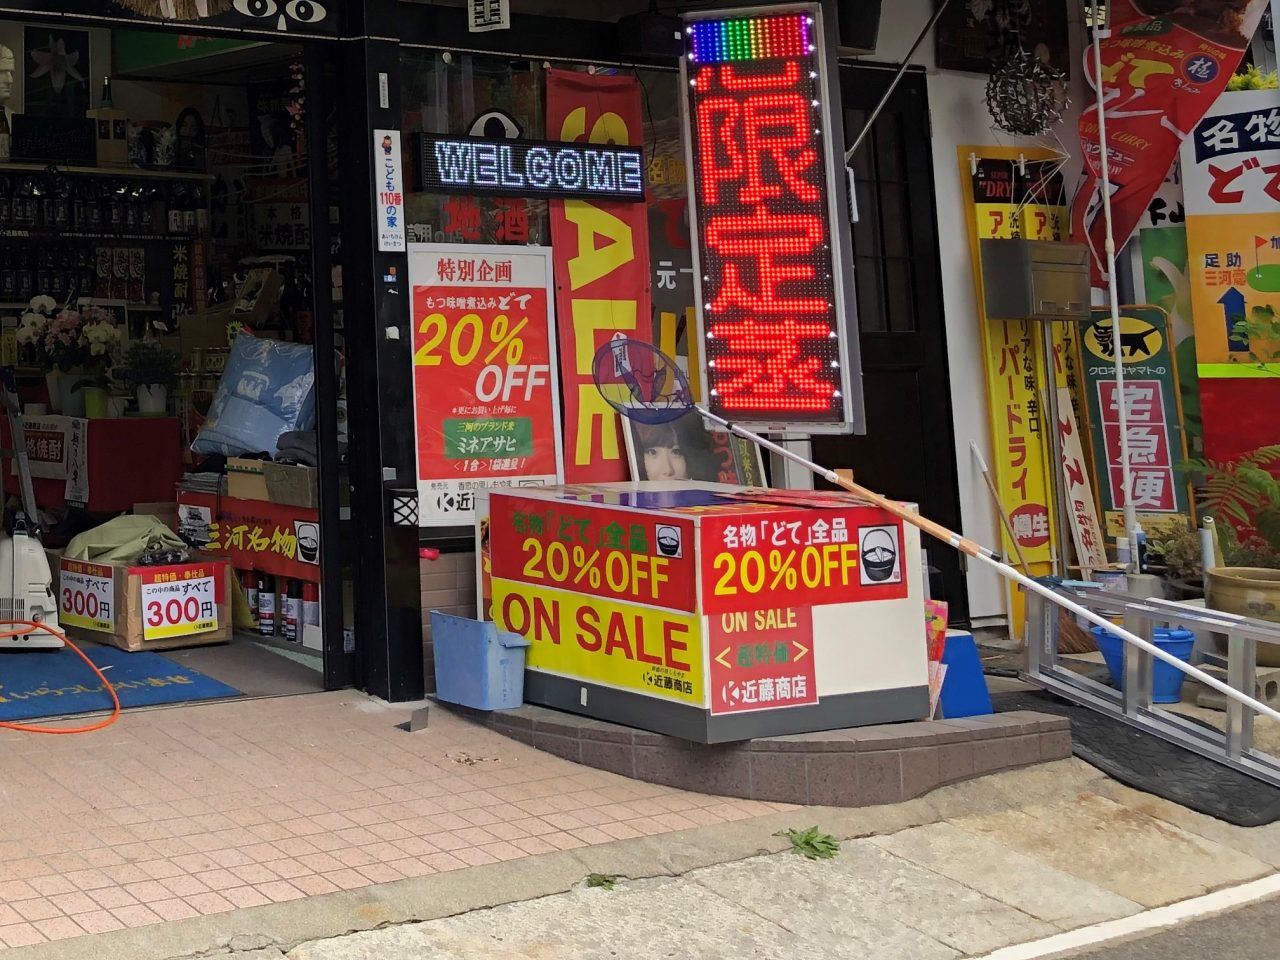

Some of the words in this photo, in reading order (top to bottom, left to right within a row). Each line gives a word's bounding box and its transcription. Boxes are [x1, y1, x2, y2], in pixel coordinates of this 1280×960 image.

[1111, 131, 1153, 150] CURRY
[1202, 109, 1280, 151] 名物
[434, 141, 642, 192] WELCOME
[380, 157, 402, 228] こども110番の家
[437, 258, 512, 283] 特別企画
[1205, 252, 1242, 268] 足助
[414, 313, 529, 366] 20%
[475, 364, 550, 403] OFF
[26, 437, 62, 461] 格焼酎
[457, 436, 517, 454] ミネアサヒ
[1110, 385, 1166, 507] 宅急便
[456, 492, 475, 512] 近
[205, 523, 297, 560] 三河名物
[723, 517, 849, 548] 名物「どて」全品
[1013, 513, 1050, 540] 樽生
[522, 537, 670, 599] 20%OFF
[713, 543, 858, 596] 20%OFF
[85, 577, 109, 593] すべて
[182, 580, 211, 596] すべて
[62, 587, 110, 619] 300円
[147, 596, 213, 627] 300円
[502, 592, 561, 646] ON
[575, 605, 691, 672] SALE
[722, 611, 748, 633] ON
[754, 607, 797, 631] SALE
[653, 674, 693, 695] 近藤商店
[741, 675, 807, 704] 近藤商店
